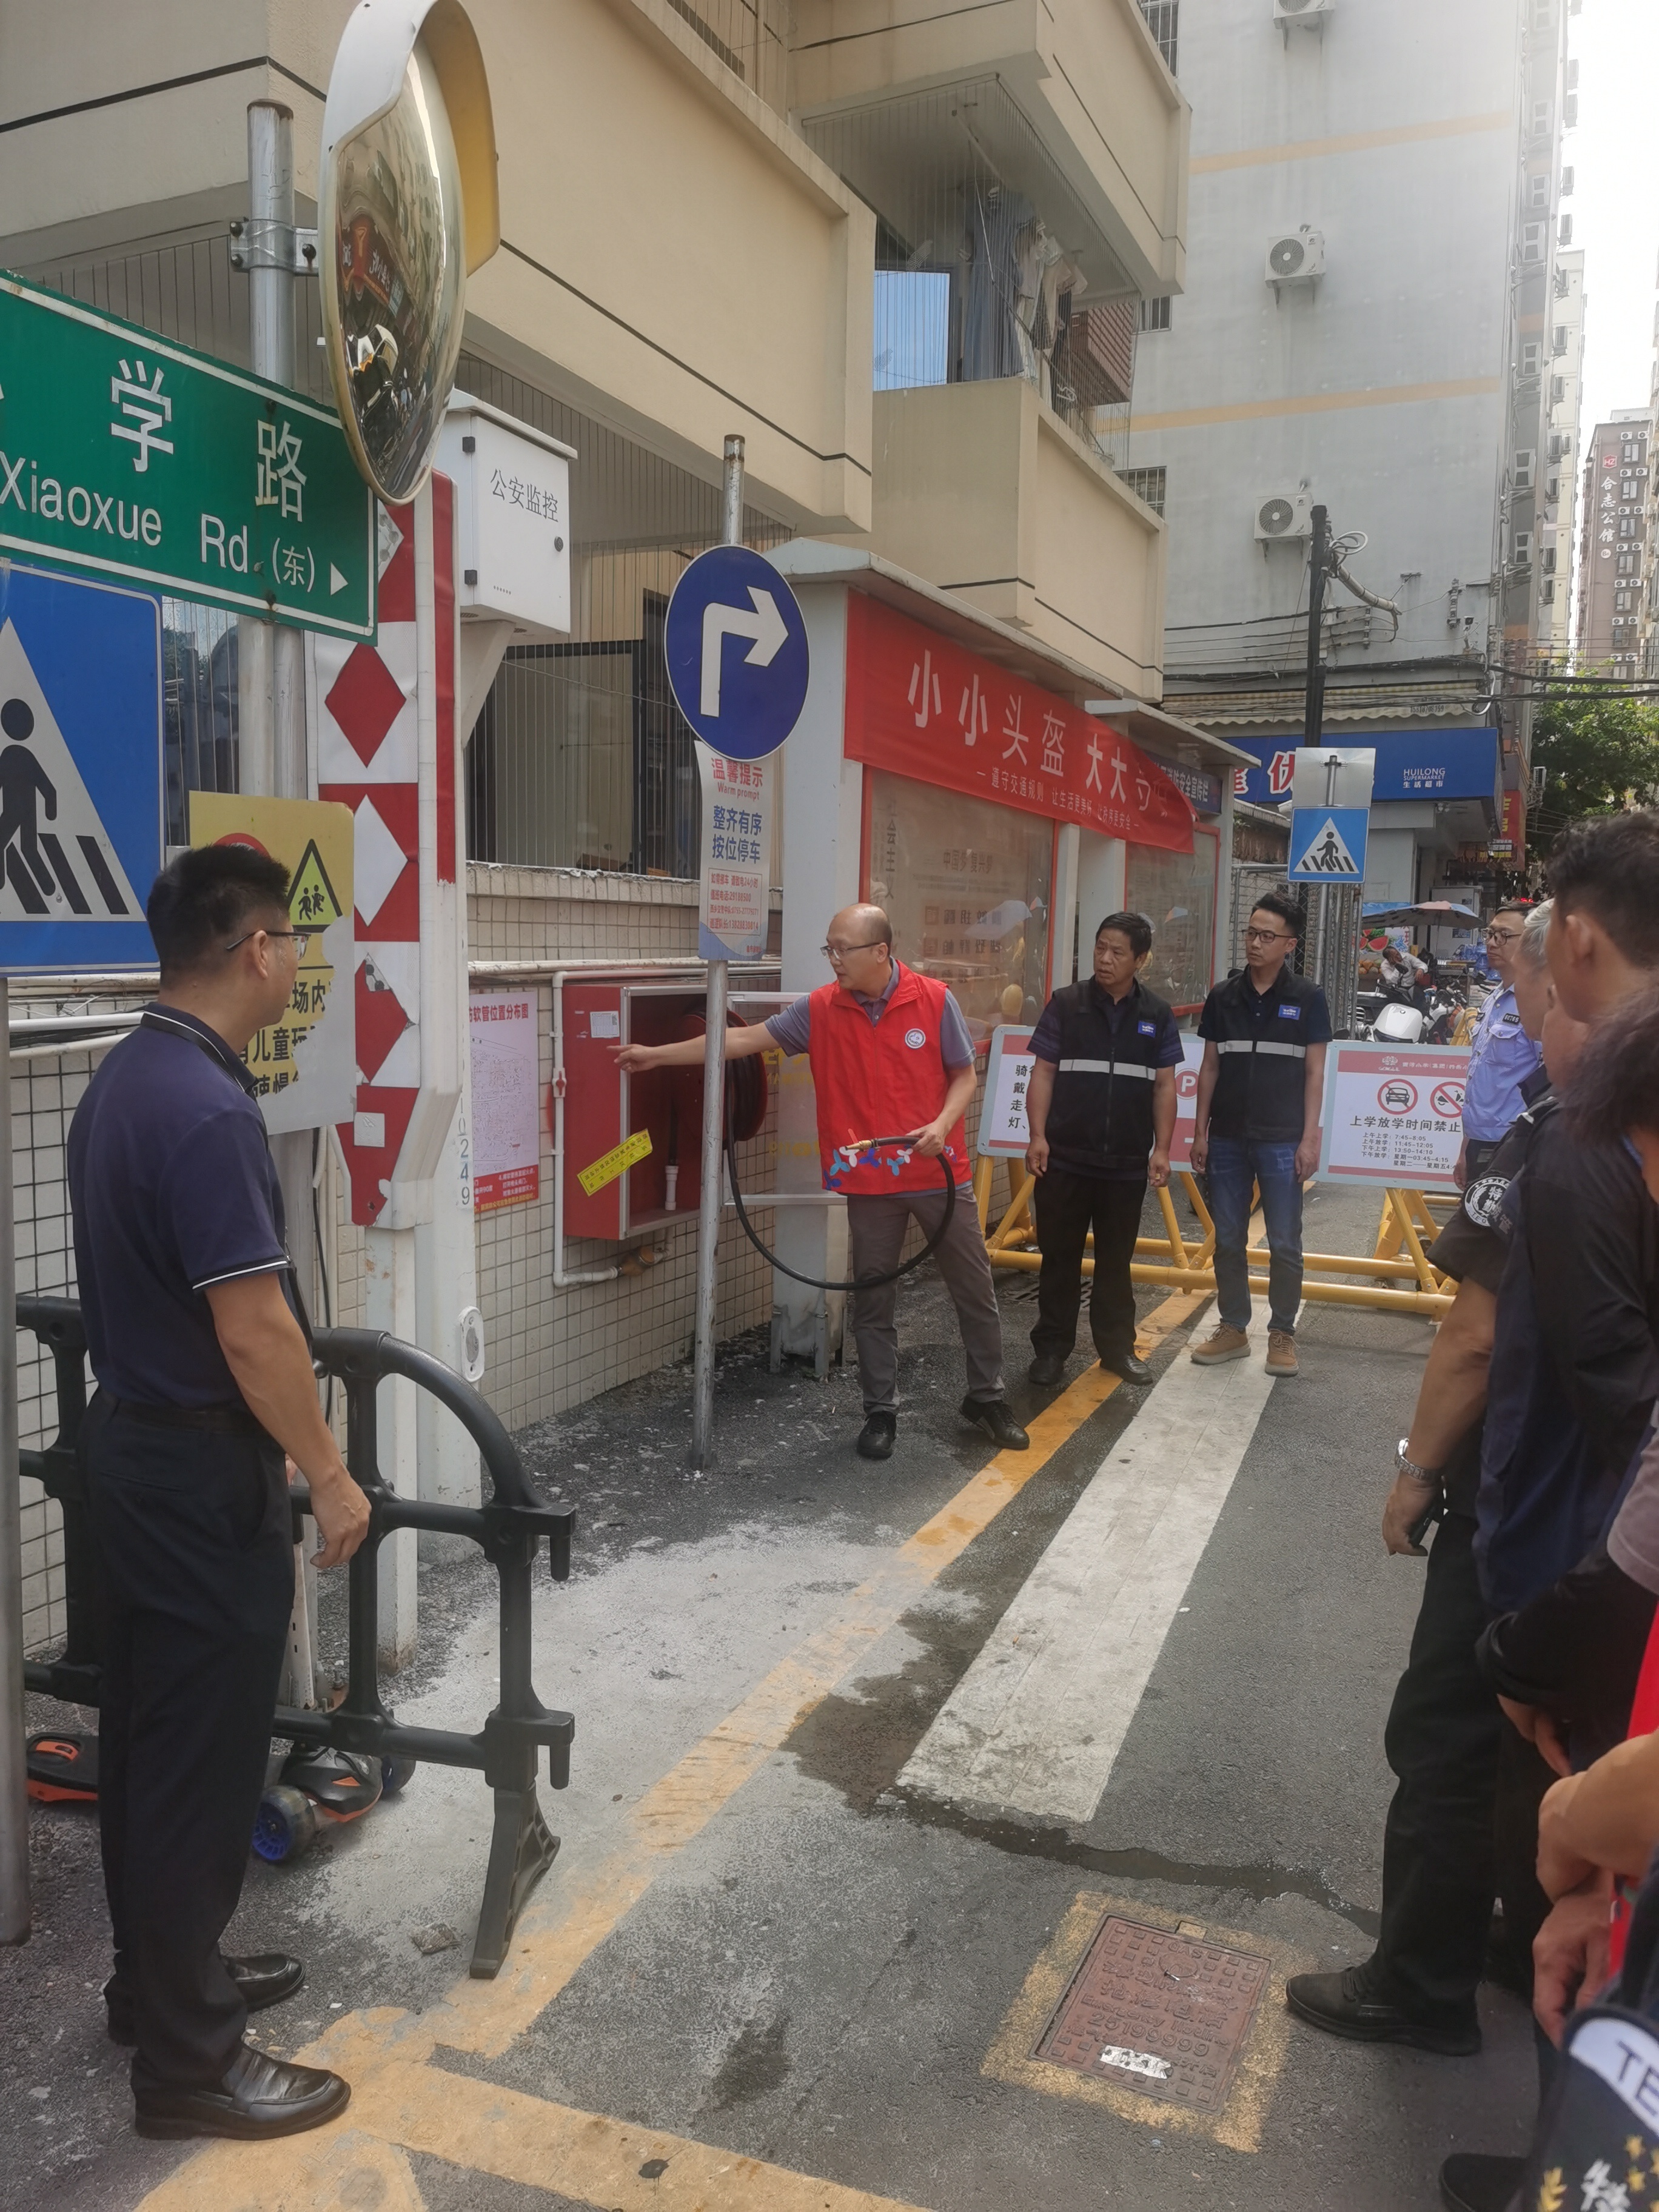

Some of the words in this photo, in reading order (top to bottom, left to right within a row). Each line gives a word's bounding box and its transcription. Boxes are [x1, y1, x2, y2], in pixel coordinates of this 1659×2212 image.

[0, 358, 307, 523] 学路
[489, 468, 559, 524] 公安监控
[1598, 476, 1618, 542] 合志公馆
[0, 451, 163, 546] Xiaoxue
[201, 512, 249, 574] Rd
[907, 649, 1067, 777] 小小头盔
[711, 758, 763, 788] 温馨提示
[1403, 767, 1446, 776] HUILONG
[717, 782, 736, 796] Warm
[737, 789, 760, 802] prompt
[991, 766, 1044, 802] 遵守交通规则
[1052, 787, 1092, 817] 让生活更美好
[713, 805, 762, 836] 整齐有序
[712, 834, 761, 865] 按位停车
[1013, 1082, 1025, 1094] 戴
[1181, 1076, 1196, 1092] P
[1010, 1099, 1027, 1111] 走
[1350, 1116, 1461, 1133] 上学放学时间禁止
[1168, 1941, 1202, 1959] GAS
[1088, 2012, 1210, 2057] 25199999
